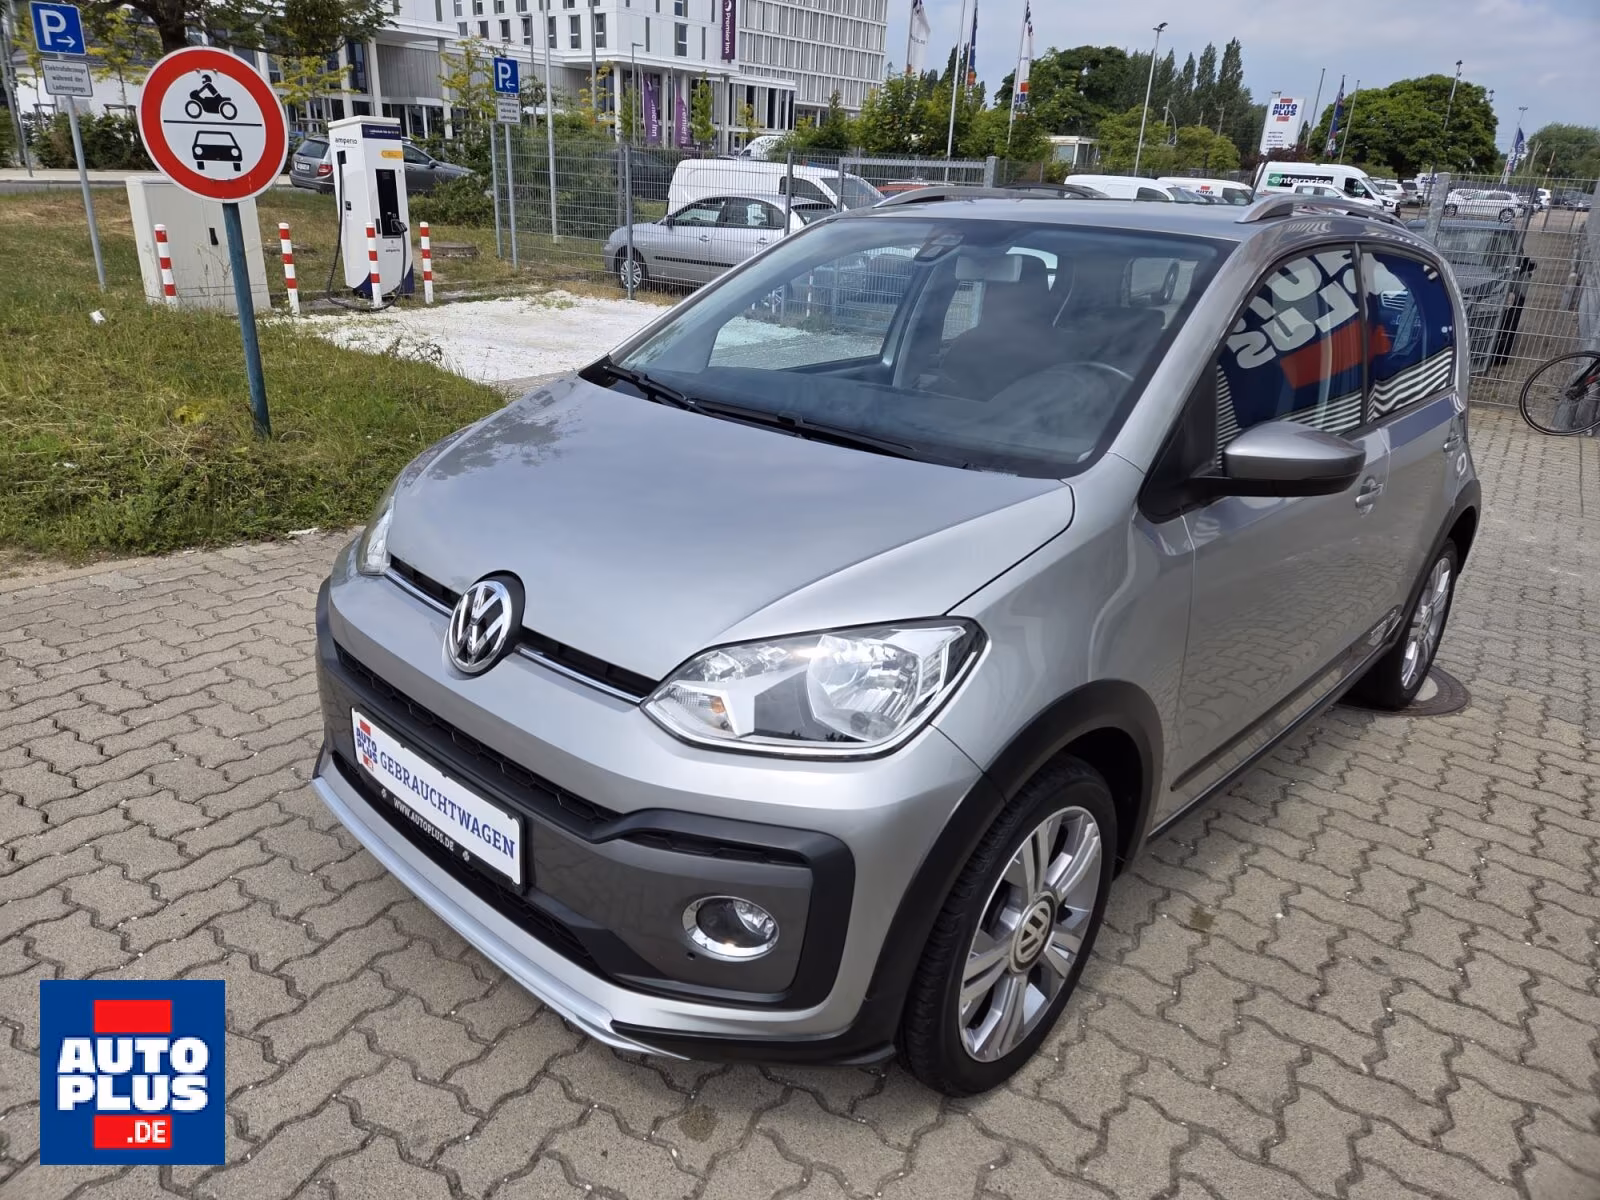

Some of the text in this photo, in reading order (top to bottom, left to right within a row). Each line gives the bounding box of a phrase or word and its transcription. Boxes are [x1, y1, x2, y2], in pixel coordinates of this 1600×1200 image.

[39, 9, 67, 46] P
[498, 62, 512, 88] P
[356, 727, 377, 753] AUTO
[357, 738, 378, 764] PLUS
[380, 751, 515, 859] GEBRAUCHTWAGEN
[393, 797, 454, 852] WWW.AUTOPLUS.DE
